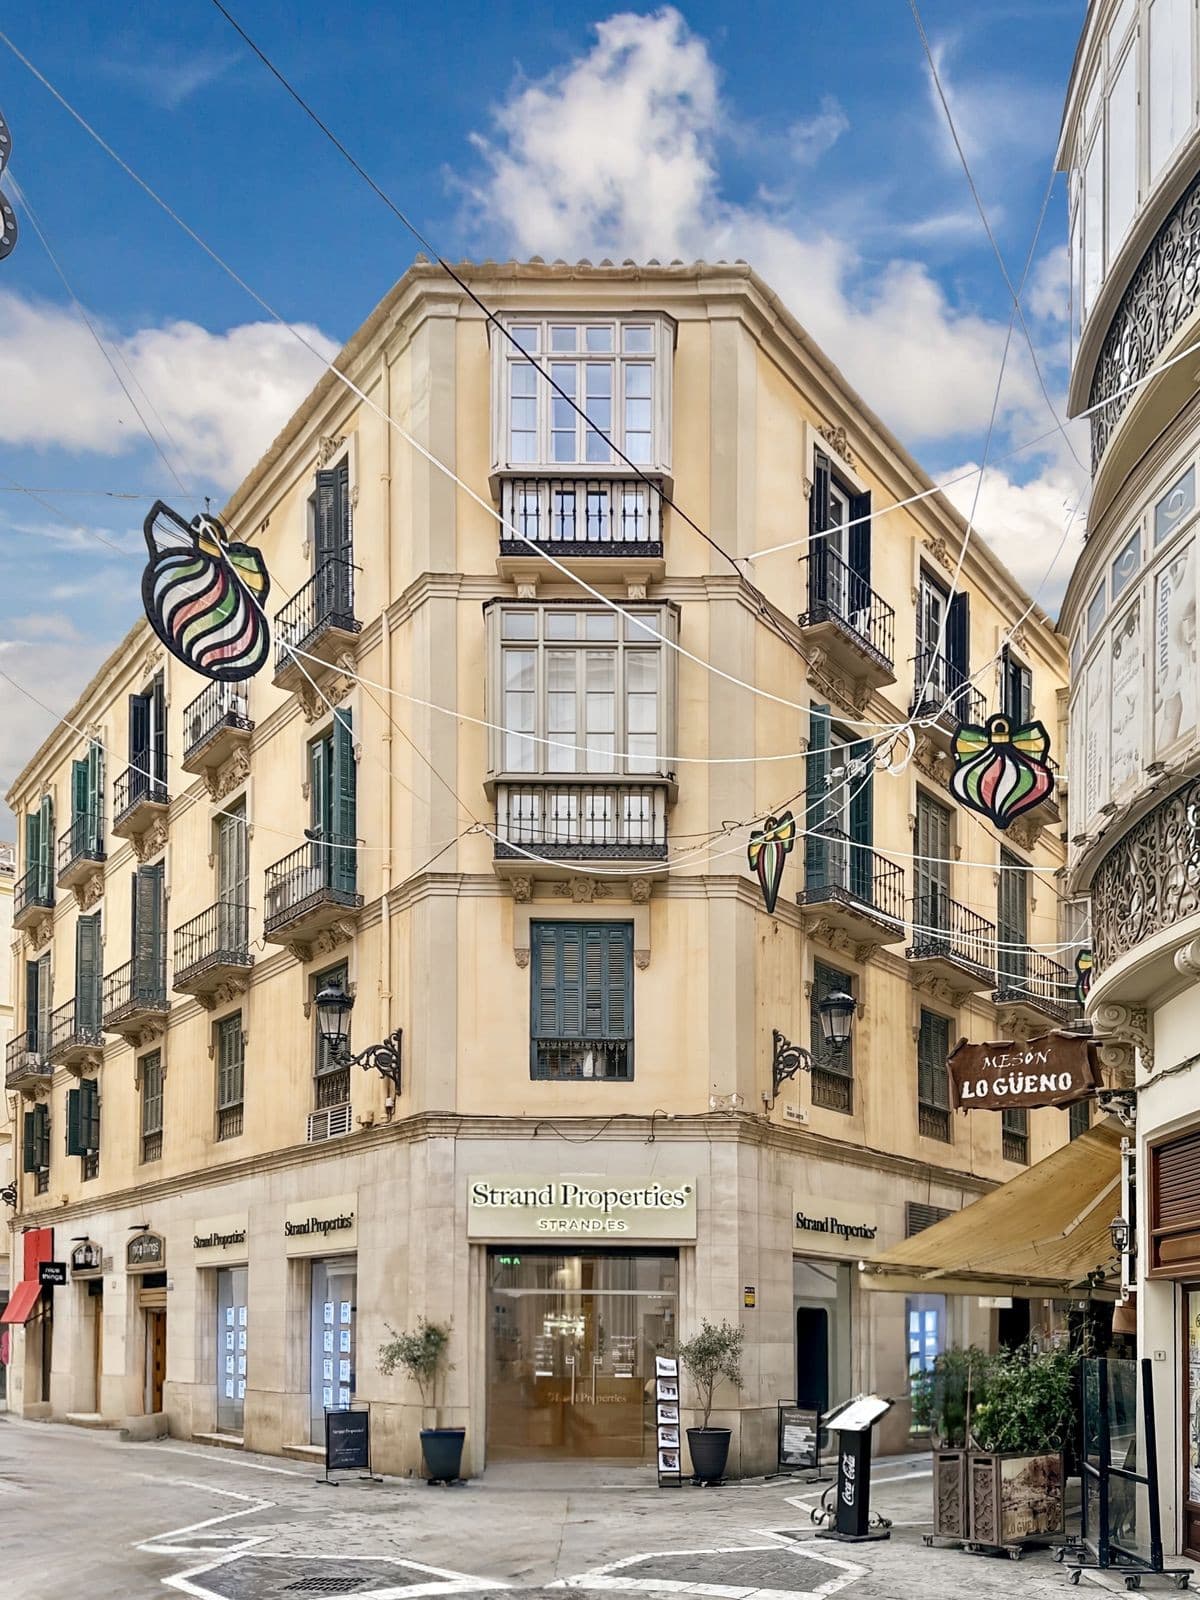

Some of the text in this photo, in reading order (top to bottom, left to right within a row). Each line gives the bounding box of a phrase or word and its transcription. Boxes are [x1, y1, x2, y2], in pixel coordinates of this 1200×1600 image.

[1157, 575, 1171, 674] invisalign
[982, 1046, 1051, 1070] MESÓN
[961, 1071, 1073, 1099] LO GÜENO
[472, 1183, 685, 1214] Strand Properties
[284, 1213, 352, 1237] Strand Properties
[538, 1219, 626, 1231] STRAND.ES
[796, 1211, 875, 1241] Strand Properties
[193, 1229, 245, 1249] Strand Properties
[41, 1272, 63, 1281] things
